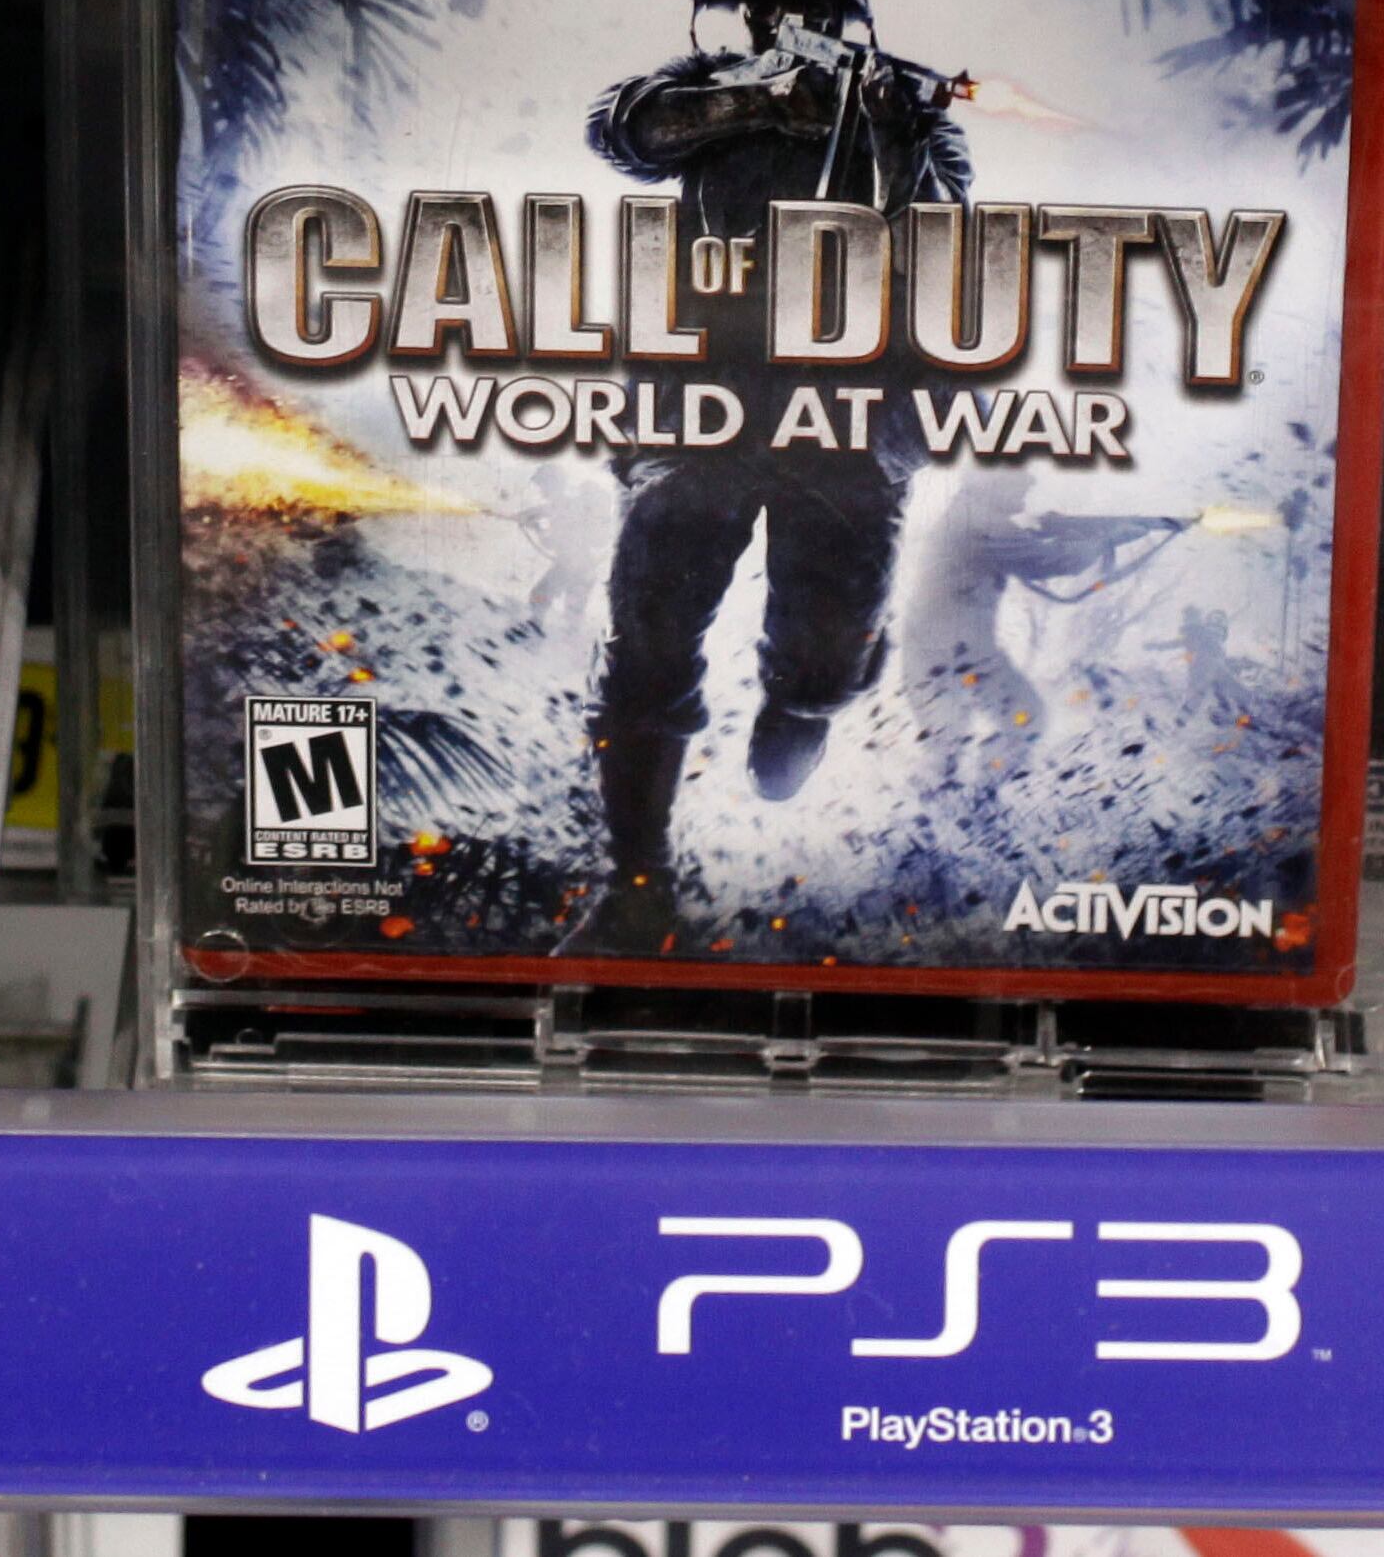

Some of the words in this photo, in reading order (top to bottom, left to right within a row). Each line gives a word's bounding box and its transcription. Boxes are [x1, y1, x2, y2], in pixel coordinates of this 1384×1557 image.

[244, 184, 707, 367] CALL
[690, 236, 756, 294] OF
[768, 200, 1288, 385] DUTY
[390, 375, 745, 447] WORLD
[770, 388, 884, 450] AT
[912, 389, 1129, 457] WAR
[253, 703, 331, 722] MATURE
[338, 705, 368, 722] 17+
[260, 731, 364, 823] M
[254, 843, 368, 859] ESRB
[221, 876, 274, 892] Online
[278, 877, 370, 894] Interactions
[375, 880, 403, 896] Not
[235, 897, 283, 914] Rated
[341, 899, 390, 915] ESRB
[657, 1217, 1303, 1361] PS3
